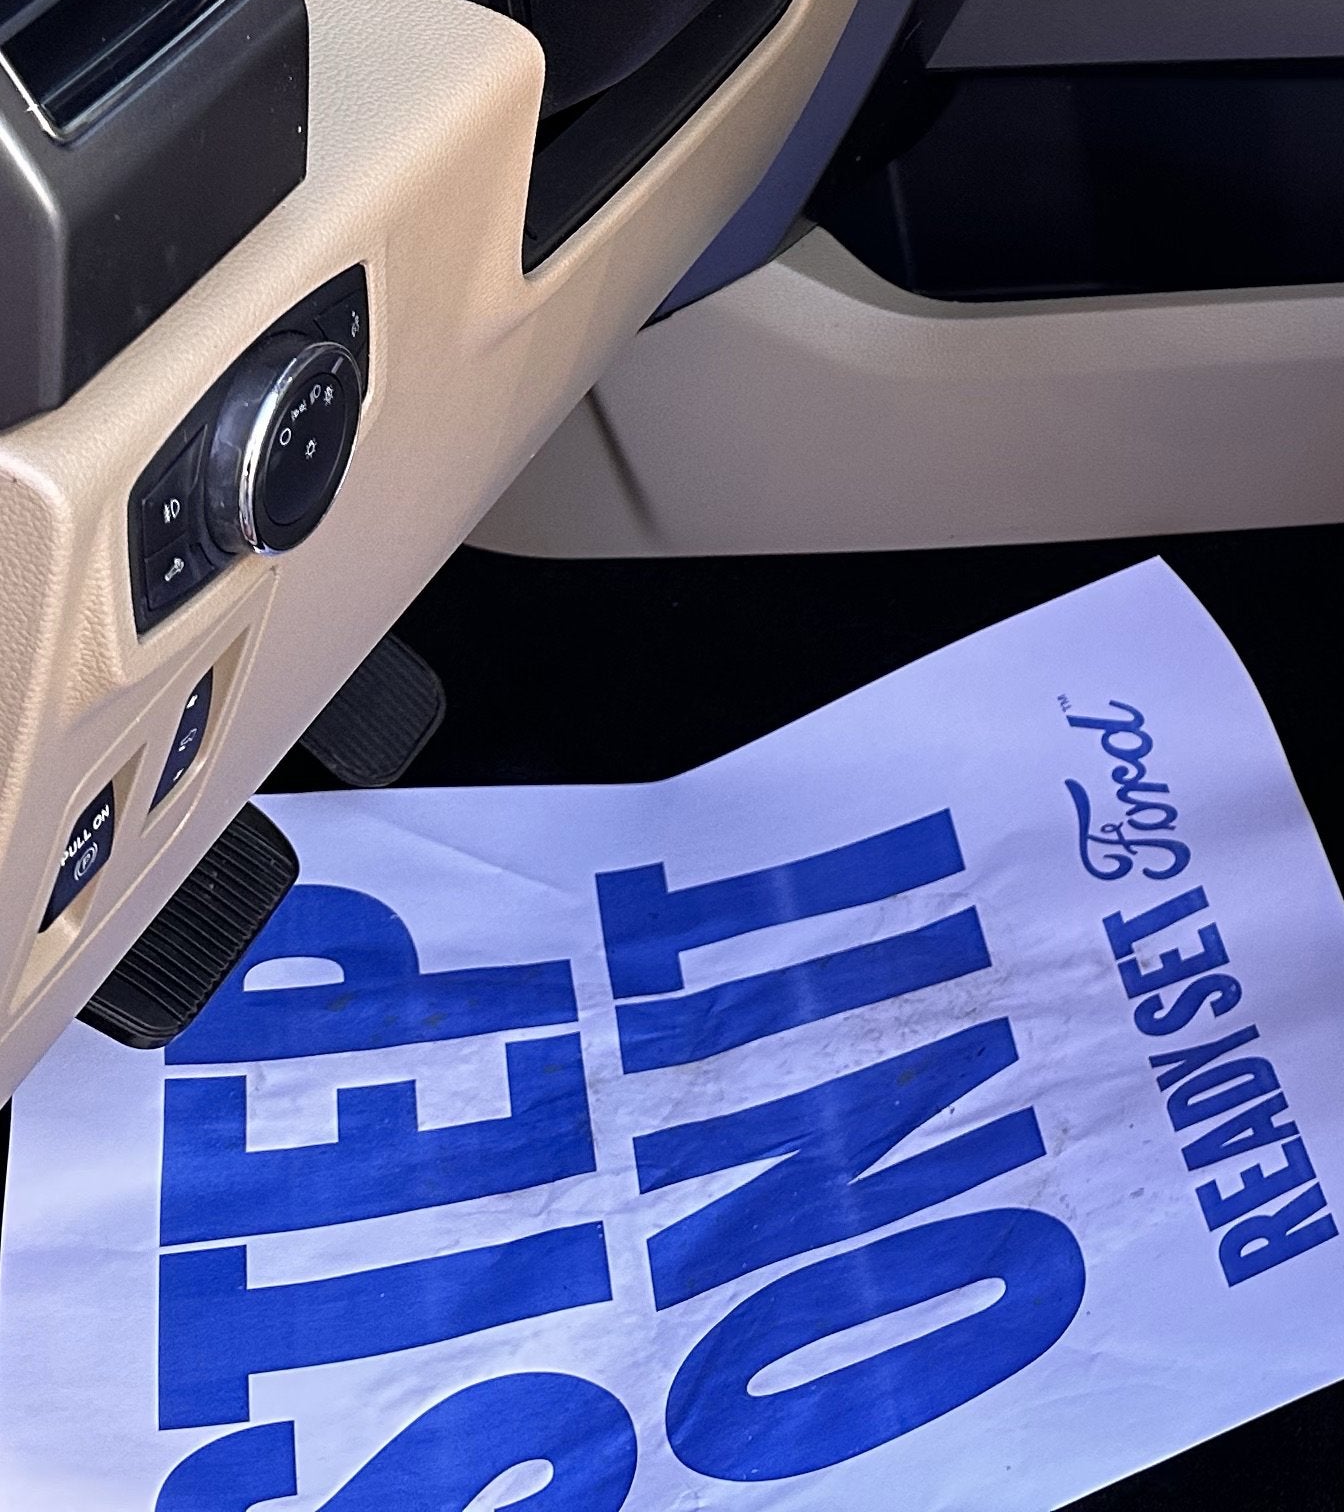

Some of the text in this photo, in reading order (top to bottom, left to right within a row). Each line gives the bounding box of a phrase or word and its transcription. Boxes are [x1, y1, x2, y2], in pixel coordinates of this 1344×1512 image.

[60, 803, 110, 866] PULL ON
[1064, 699, 1192, 882] Ford
[1102, 884, 1244, 1038] SET
[153, 884, 640, 1512] STEP
[595, 808, 1087, 1482] ON IT
[1148, 1023, 1340, 1288] READY
